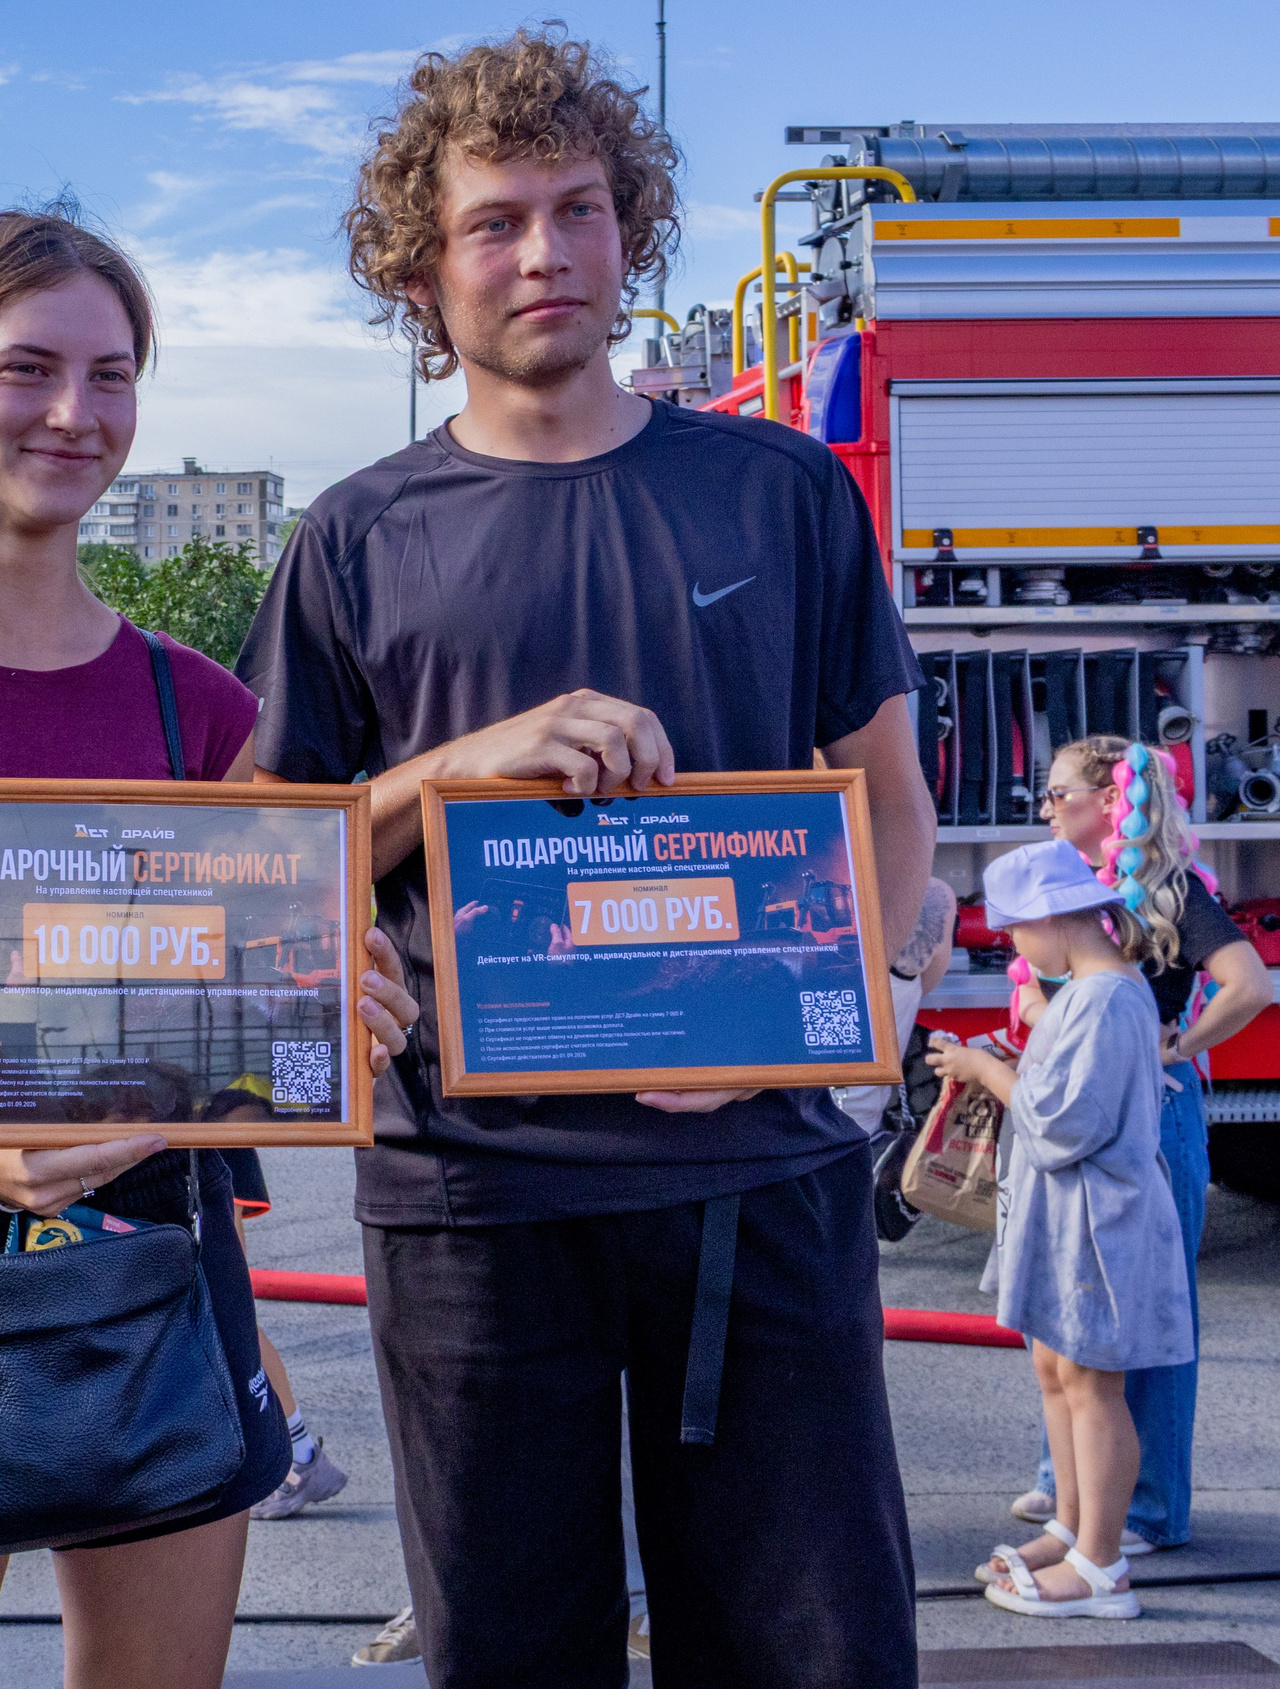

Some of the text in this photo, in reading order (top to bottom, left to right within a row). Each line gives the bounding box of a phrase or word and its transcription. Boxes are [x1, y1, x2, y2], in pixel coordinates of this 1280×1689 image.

[639, 812, 689, 824] ДРАЙВ
[121, 826, 175, 839] ДРАЙВ
[483, 828, 810, 868] ПОДАРОЧНЫЙ СЕРТИФИКАТ
[133, 851, 301, 884] СЕРТИФИКАТ
[566, 862, 729, 876] На управление настоящей спецтехникой
[35, 885, 212, 897] На управление настоящей спецтехникой
[574, 895, 732, 934] 7 000 РУБ.
[33, 924, 218, 965] 10 000 РУБ.
[476, 954, 519, 965] Действует
[532, 951, 592, 963] VR-симулятор,
[593, 950, 661, 960] индивидуальное
[669, 948, 731, 958] дистанционное
[733, 946, 781, 955] управление
[782, 942, 838, 953] спецтехникой
[55, 987, 128, 996] индивидуальное
[137, 987, 204, 996] дистанционное
[207, 988, 257, 997] управление
[259, 986, 318, 997] спецтехникой
